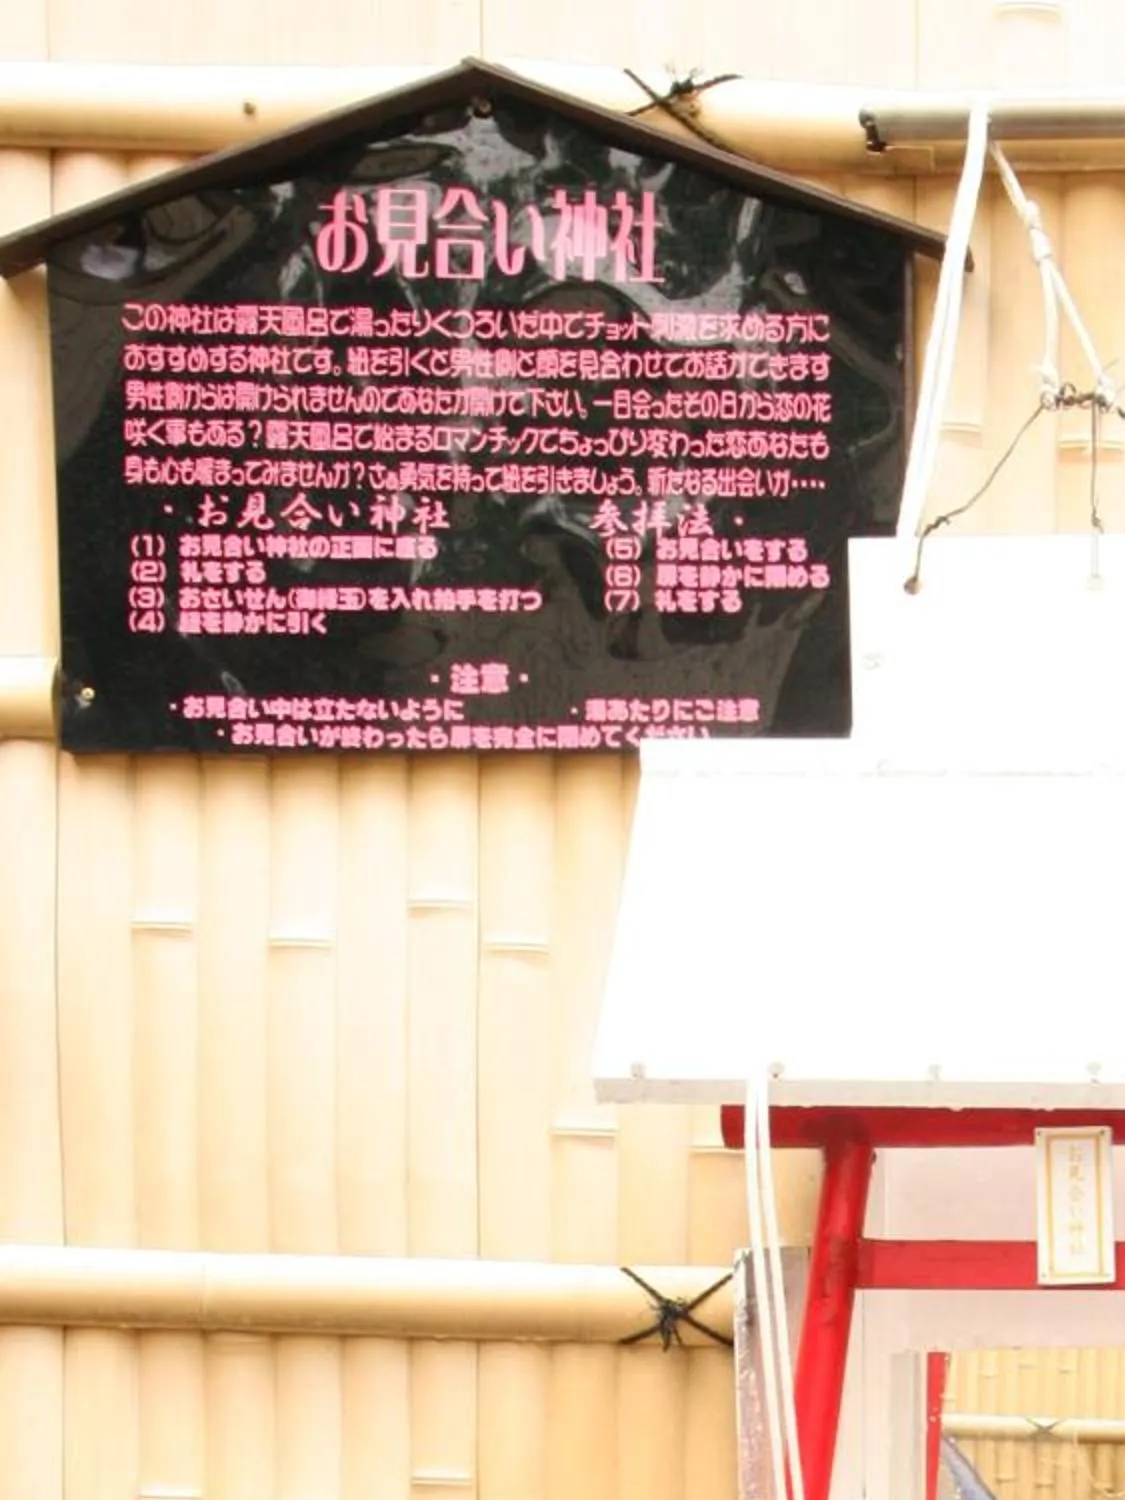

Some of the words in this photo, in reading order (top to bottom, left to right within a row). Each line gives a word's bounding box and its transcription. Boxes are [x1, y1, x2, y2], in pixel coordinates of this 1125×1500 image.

[316, 187, 665, 282] お見合い神社
